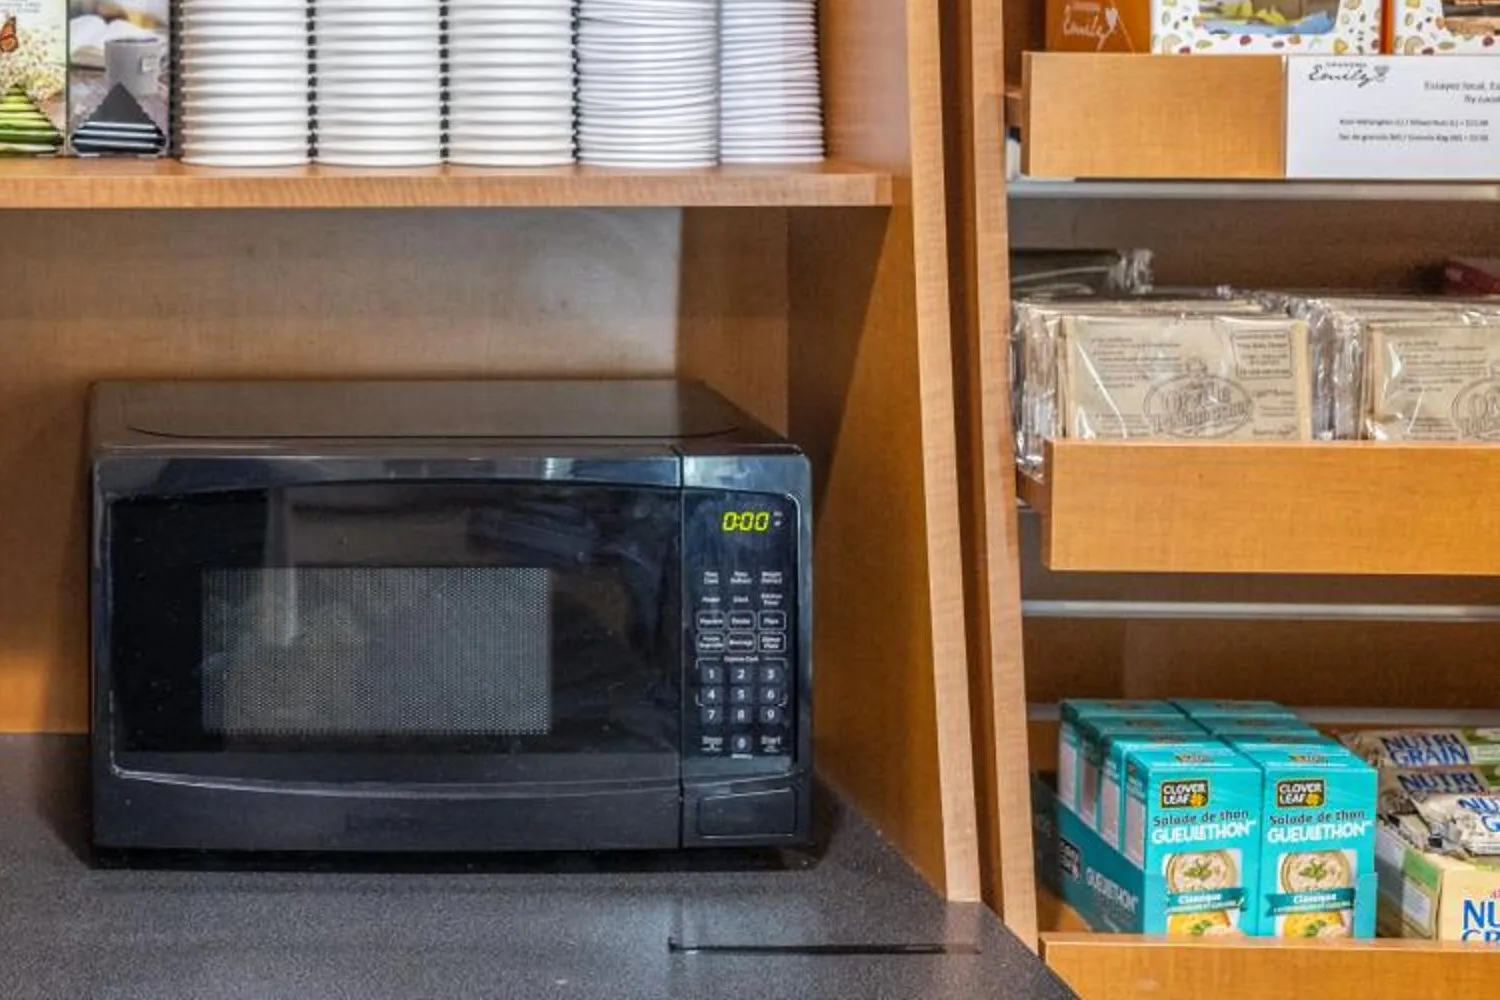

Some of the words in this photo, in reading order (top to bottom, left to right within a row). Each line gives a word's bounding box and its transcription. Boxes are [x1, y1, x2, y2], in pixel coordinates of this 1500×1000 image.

[1308, 63, 1370, 88] Emily
[723, 511, 770, 531] 0:00
[1381, 733, 1461, 751] NUTRI
[1390, 745, 1471, 766] GRAIN
[1397, 771, 1480, 791] NUTRI
[1163, 783, 1206, 795] CLOVER
[1279, 783, 1322, 795] CLOVER
[1163, 794, 1190, 805] LEAF
[1279, 794, 1306, 805] LEAF
[1203, 811, 1217, 823] de
[1316, 811, 1331, 823] de
